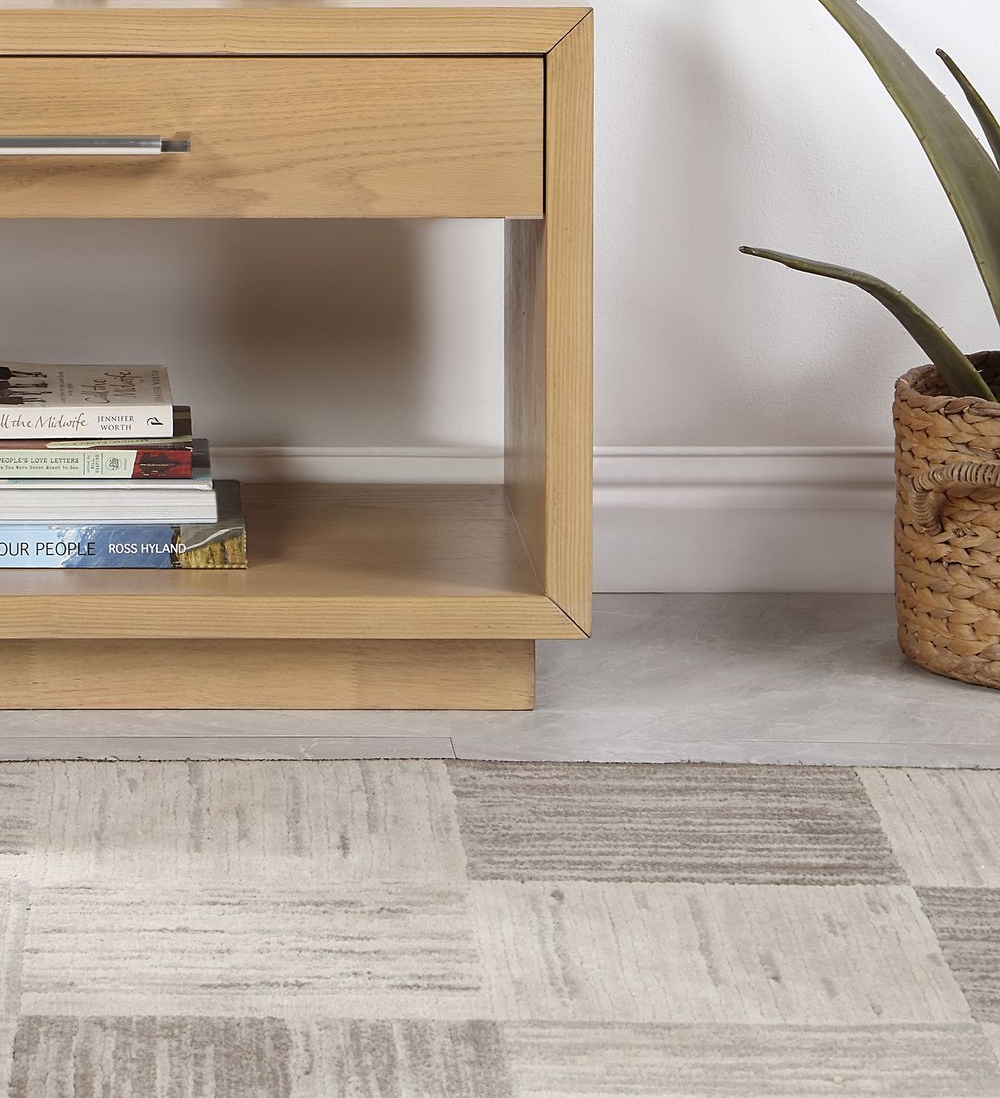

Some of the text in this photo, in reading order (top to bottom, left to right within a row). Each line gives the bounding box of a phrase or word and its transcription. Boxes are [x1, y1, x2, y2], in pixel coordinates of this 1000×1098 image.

[10, 414, 32, 428] the
[34, 412, 89, 431] Midwife
[97, 415, 135, 423] JENNIFER
[36, 542, 96, 557] PEOPLE
[108, 543, 137, 554] ROSS
[141, 543, 187, 554] HYLAND
